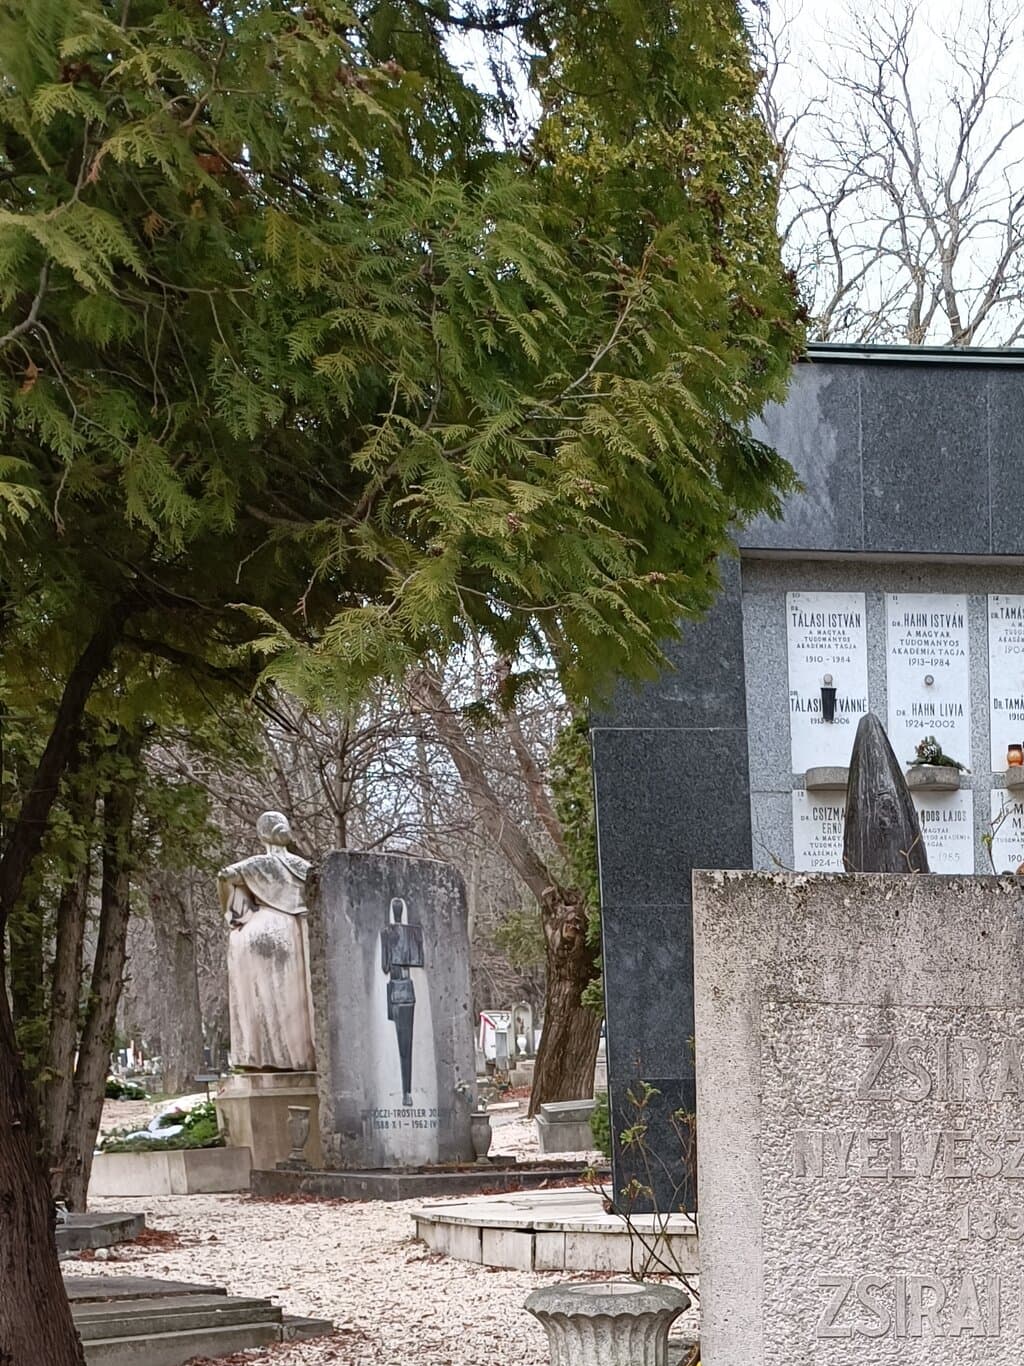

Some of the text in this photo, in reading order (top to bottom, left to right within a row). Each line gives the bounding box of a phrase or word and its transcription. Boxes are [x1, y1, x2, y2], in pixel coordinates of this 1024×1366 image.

[828, 610, 862, 628] ISTVÁN
[904, 612, 928, 628] HAHN
[930, 611, 964, 628] ISTVÁN
[906, 630, 950, 638] A MAGYAR
[805, 655, 823, 663] 1910
[832, 655, 851, 663] 1984
[938, 648, 965, 657] TAGJA
[911, 703, 936, 717] HAHN
[812, 807, 846, 822] CSIZMA
[943, 810, 967, 822] LAJOS
[412, 1120, 427, 1129] 1962
[816, 1272, 1002, 1339] ZSIRAI
